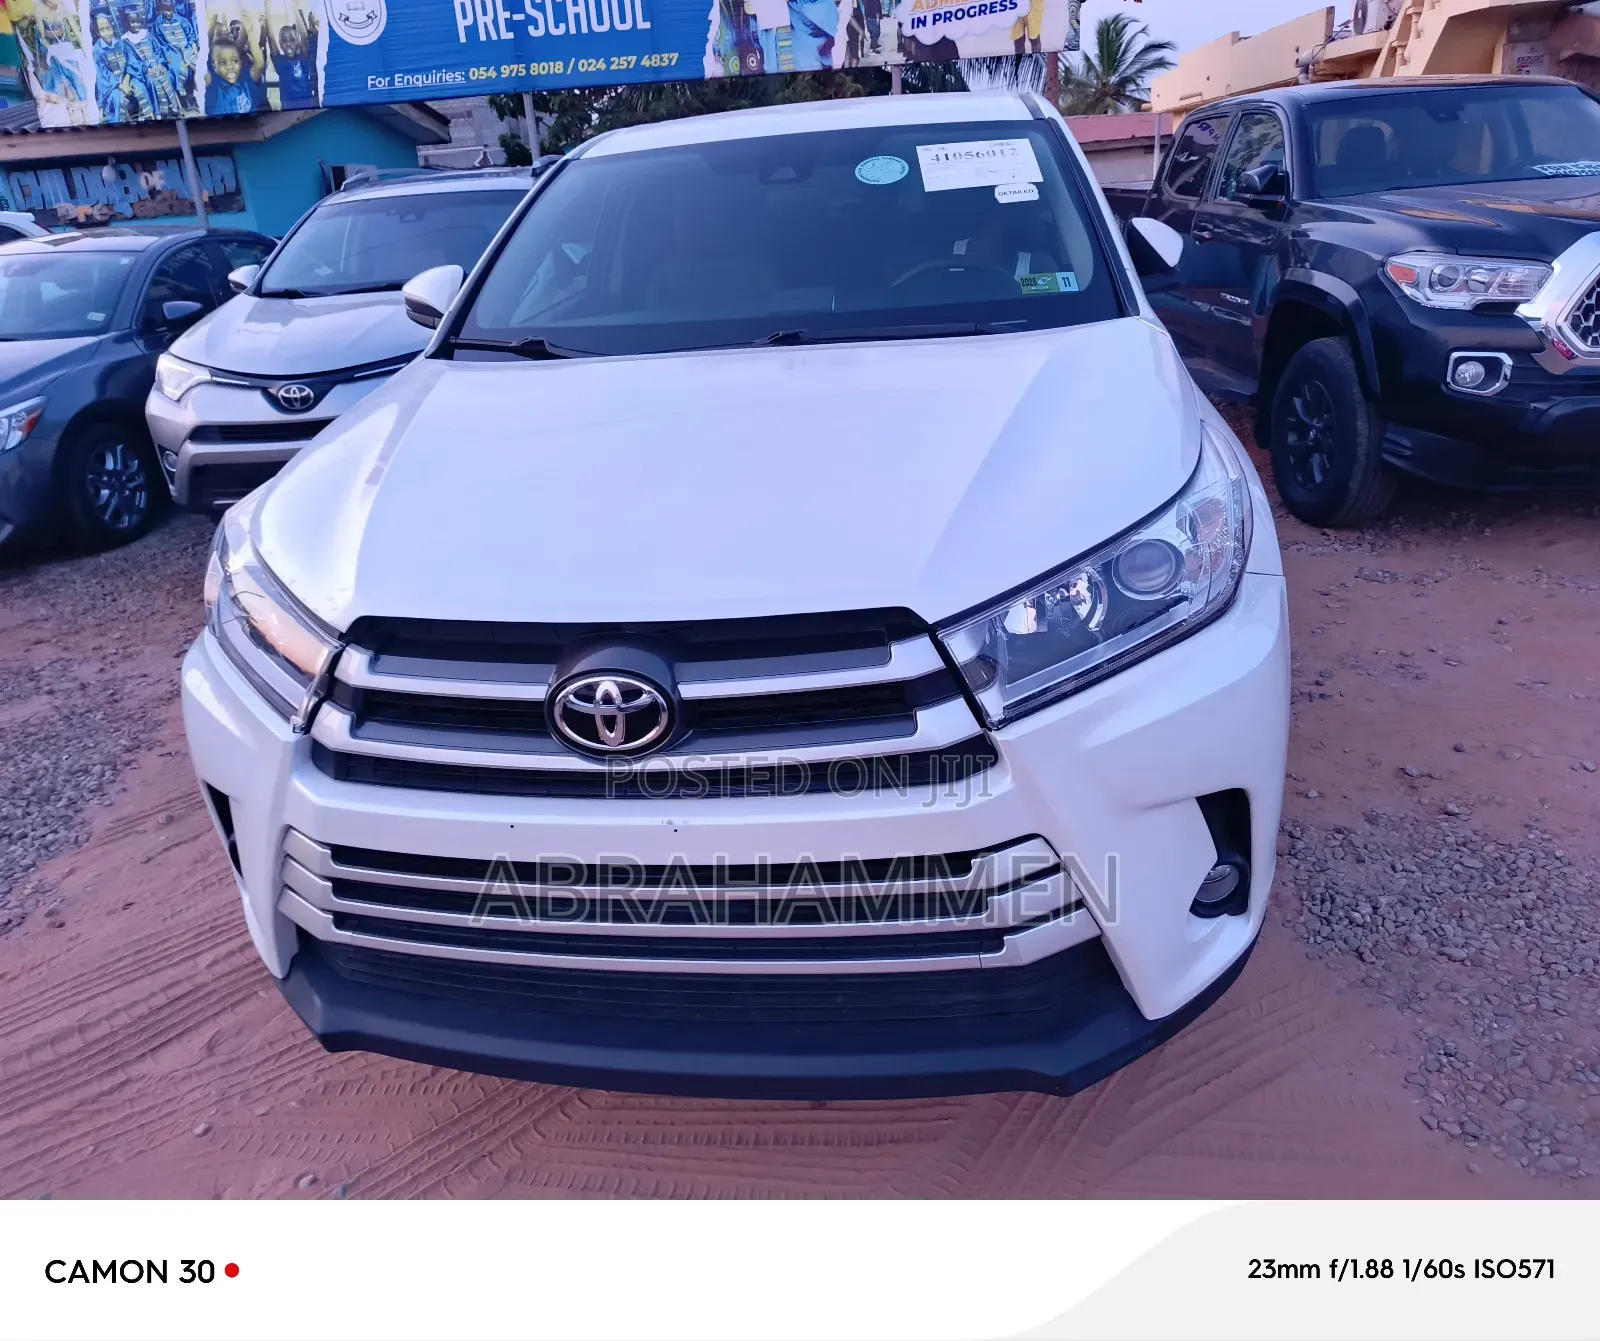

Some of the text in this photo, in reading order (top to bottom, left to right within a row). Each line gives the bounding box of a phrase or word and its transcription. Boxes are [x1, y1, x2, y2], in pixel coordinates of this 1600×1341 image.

[911, 15, 927, 29] IN
[932, 0, 1018, 25] PROGRESS
[367, 53, 680, 89] For Enquiries: 054 975 8018 / 024 257 4837
[140, 170, 165, 190] OF
[997, 188, 1034, 197] DETAILED
[1061, 276, 1072, 288] 11
